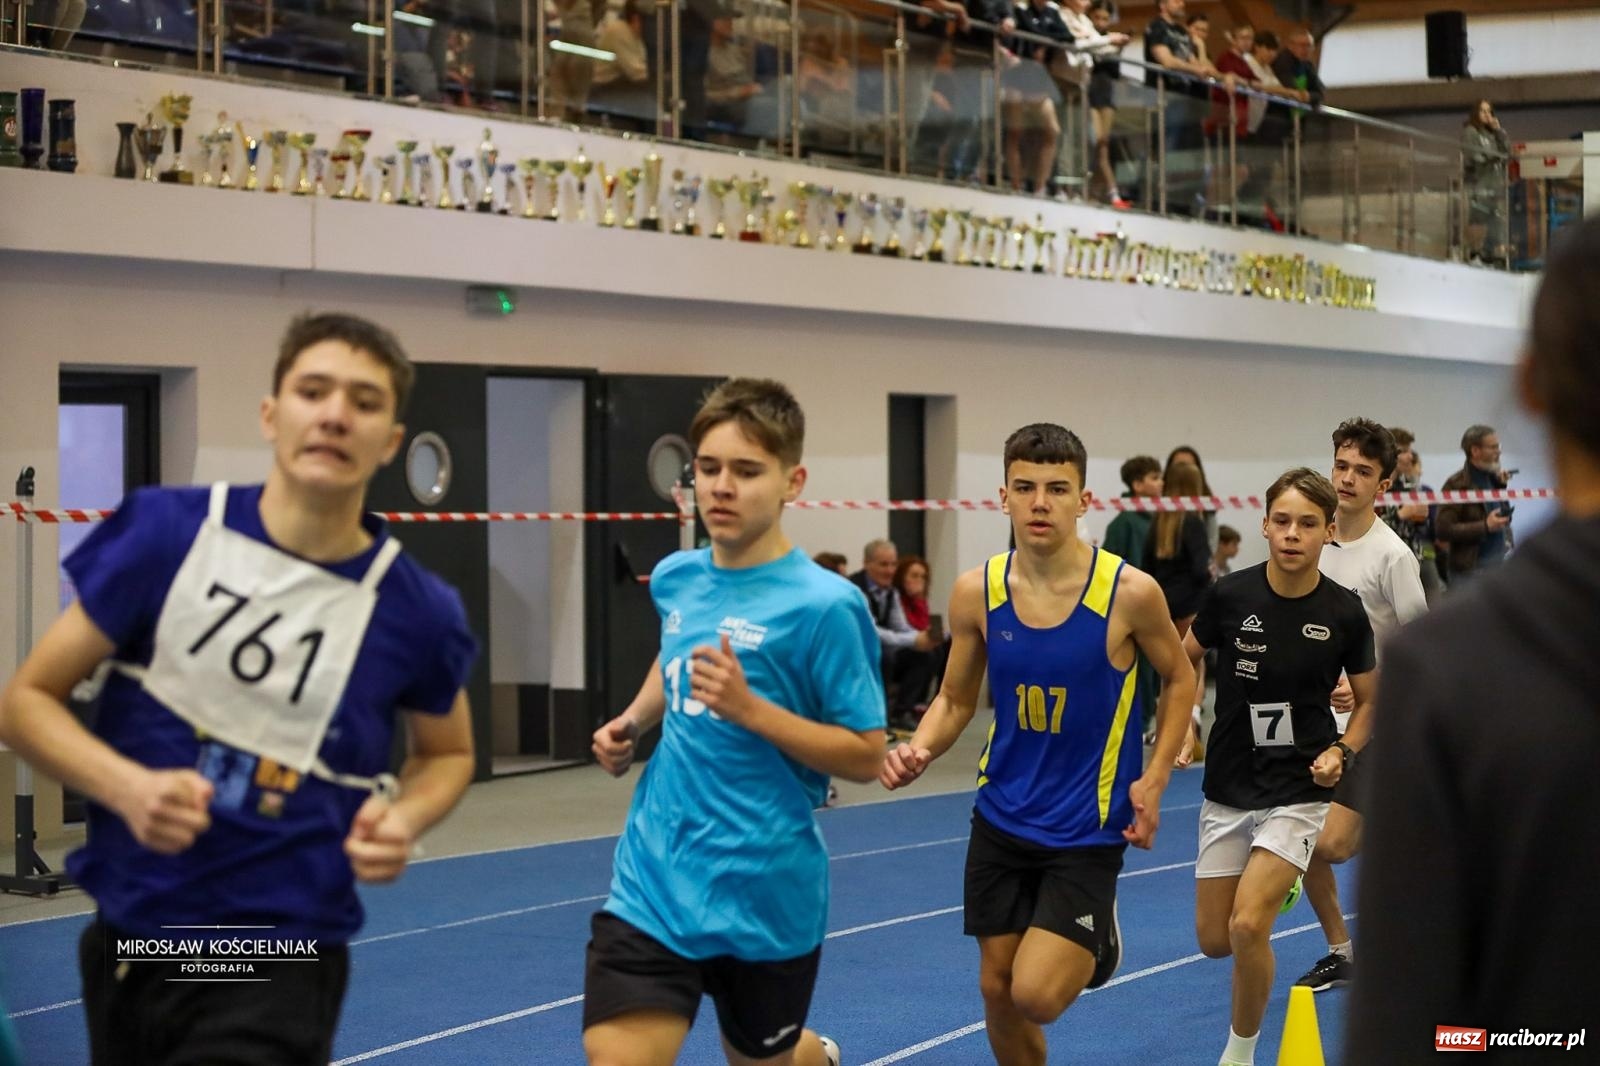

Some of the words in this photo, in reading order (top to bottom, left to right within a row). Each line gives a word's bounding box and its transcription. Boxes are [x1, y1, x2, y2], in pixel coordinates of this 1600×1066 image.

[187, 582, 324, 705] 761
[1015, 683, 1067, 734] 107
[1257, 709, 1285, 741] 7
